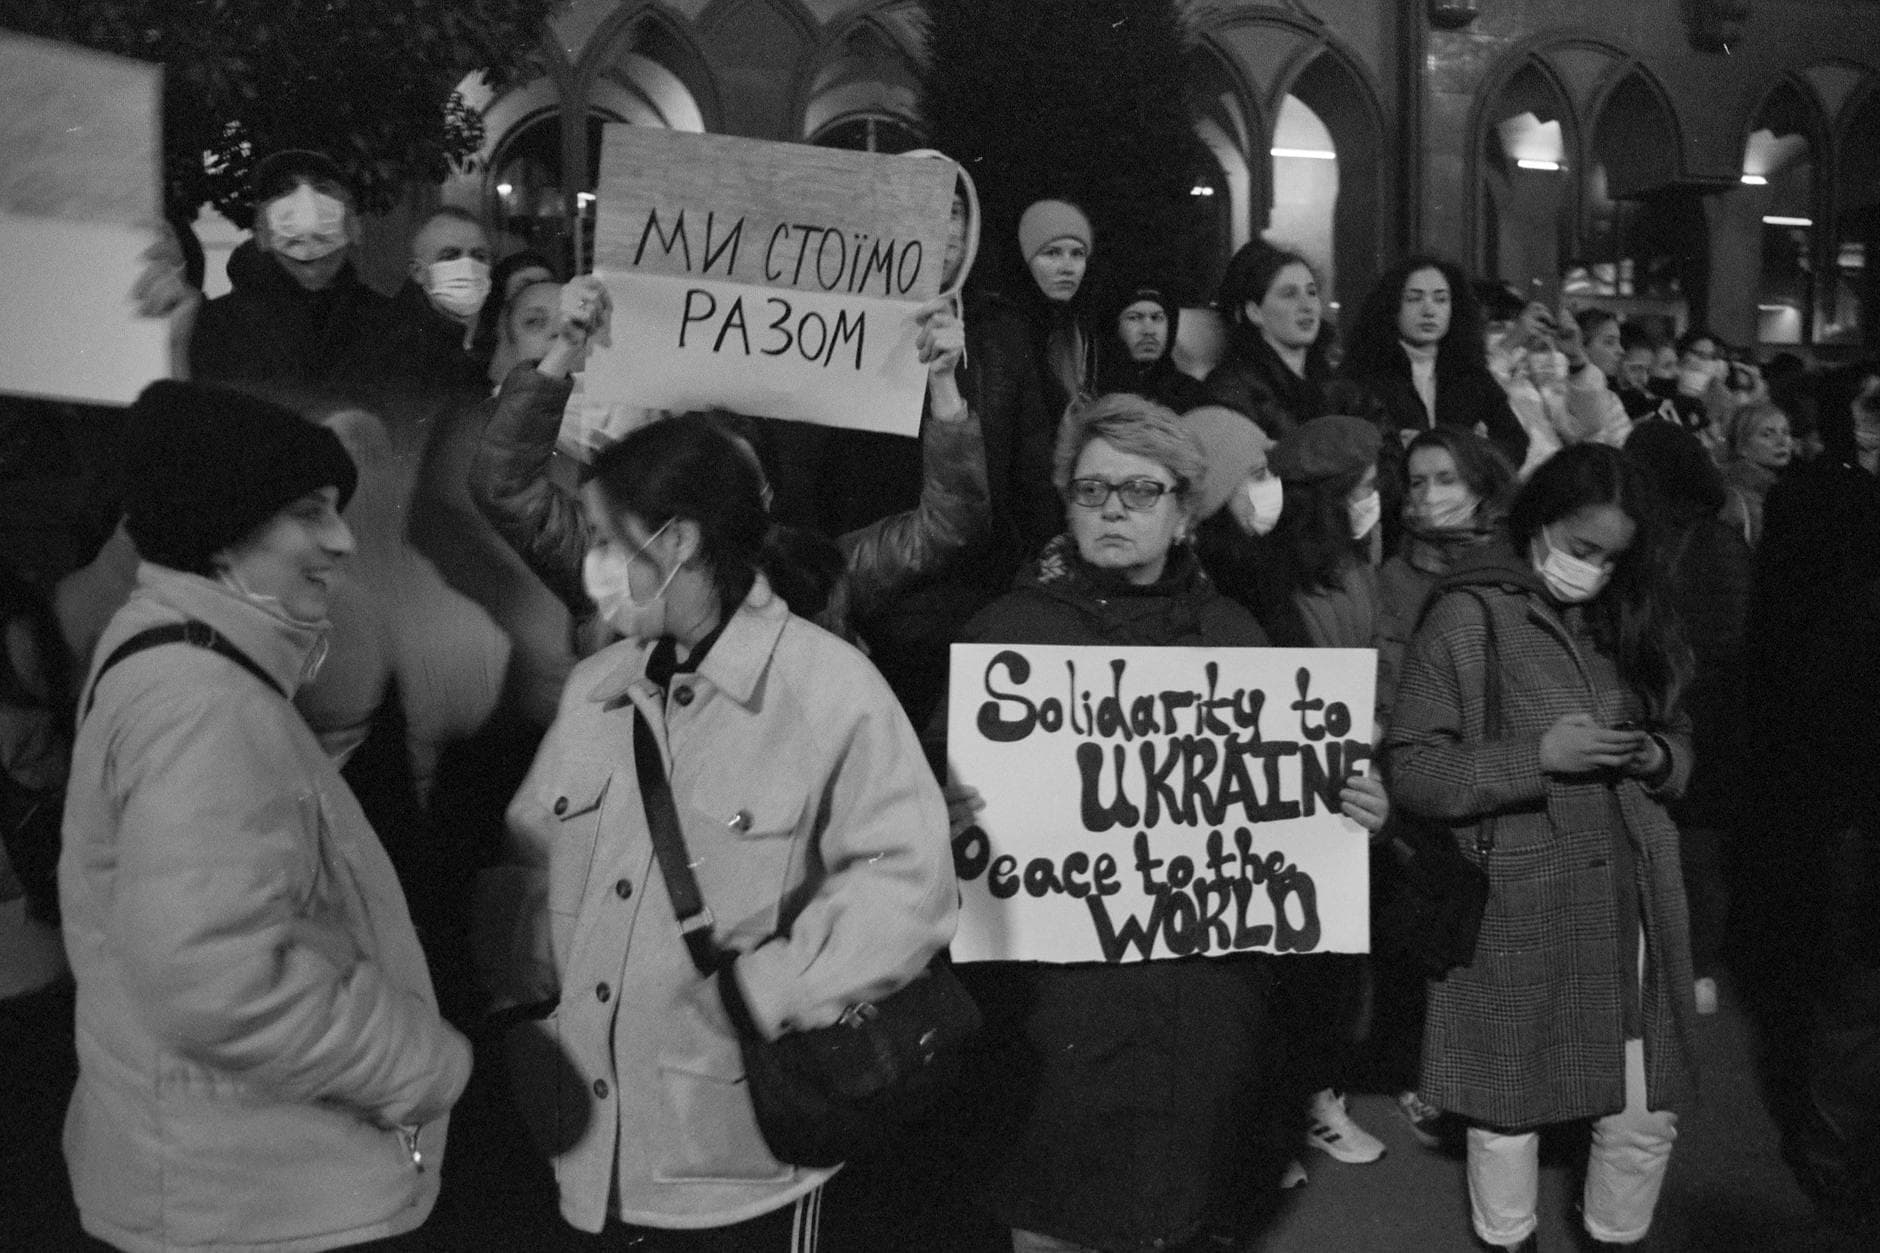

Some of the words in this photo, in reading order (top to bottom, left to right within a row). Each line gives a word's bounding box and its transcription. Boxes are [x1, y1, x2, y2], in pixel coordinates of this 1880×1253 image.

[634, 207, 745, 276] МИ
[765, 222, 922, 295] СТОЇМО
[678, 288, 866, 370] РАЗОМ
[976, 650, 1266, 745] Solidarity
[1291, 667, 1351, 741] to
[1133, 831, 1194, 895] to
[1206, 826, 1298, 888] the
[1086, 871, 1321, 963] WORLD
